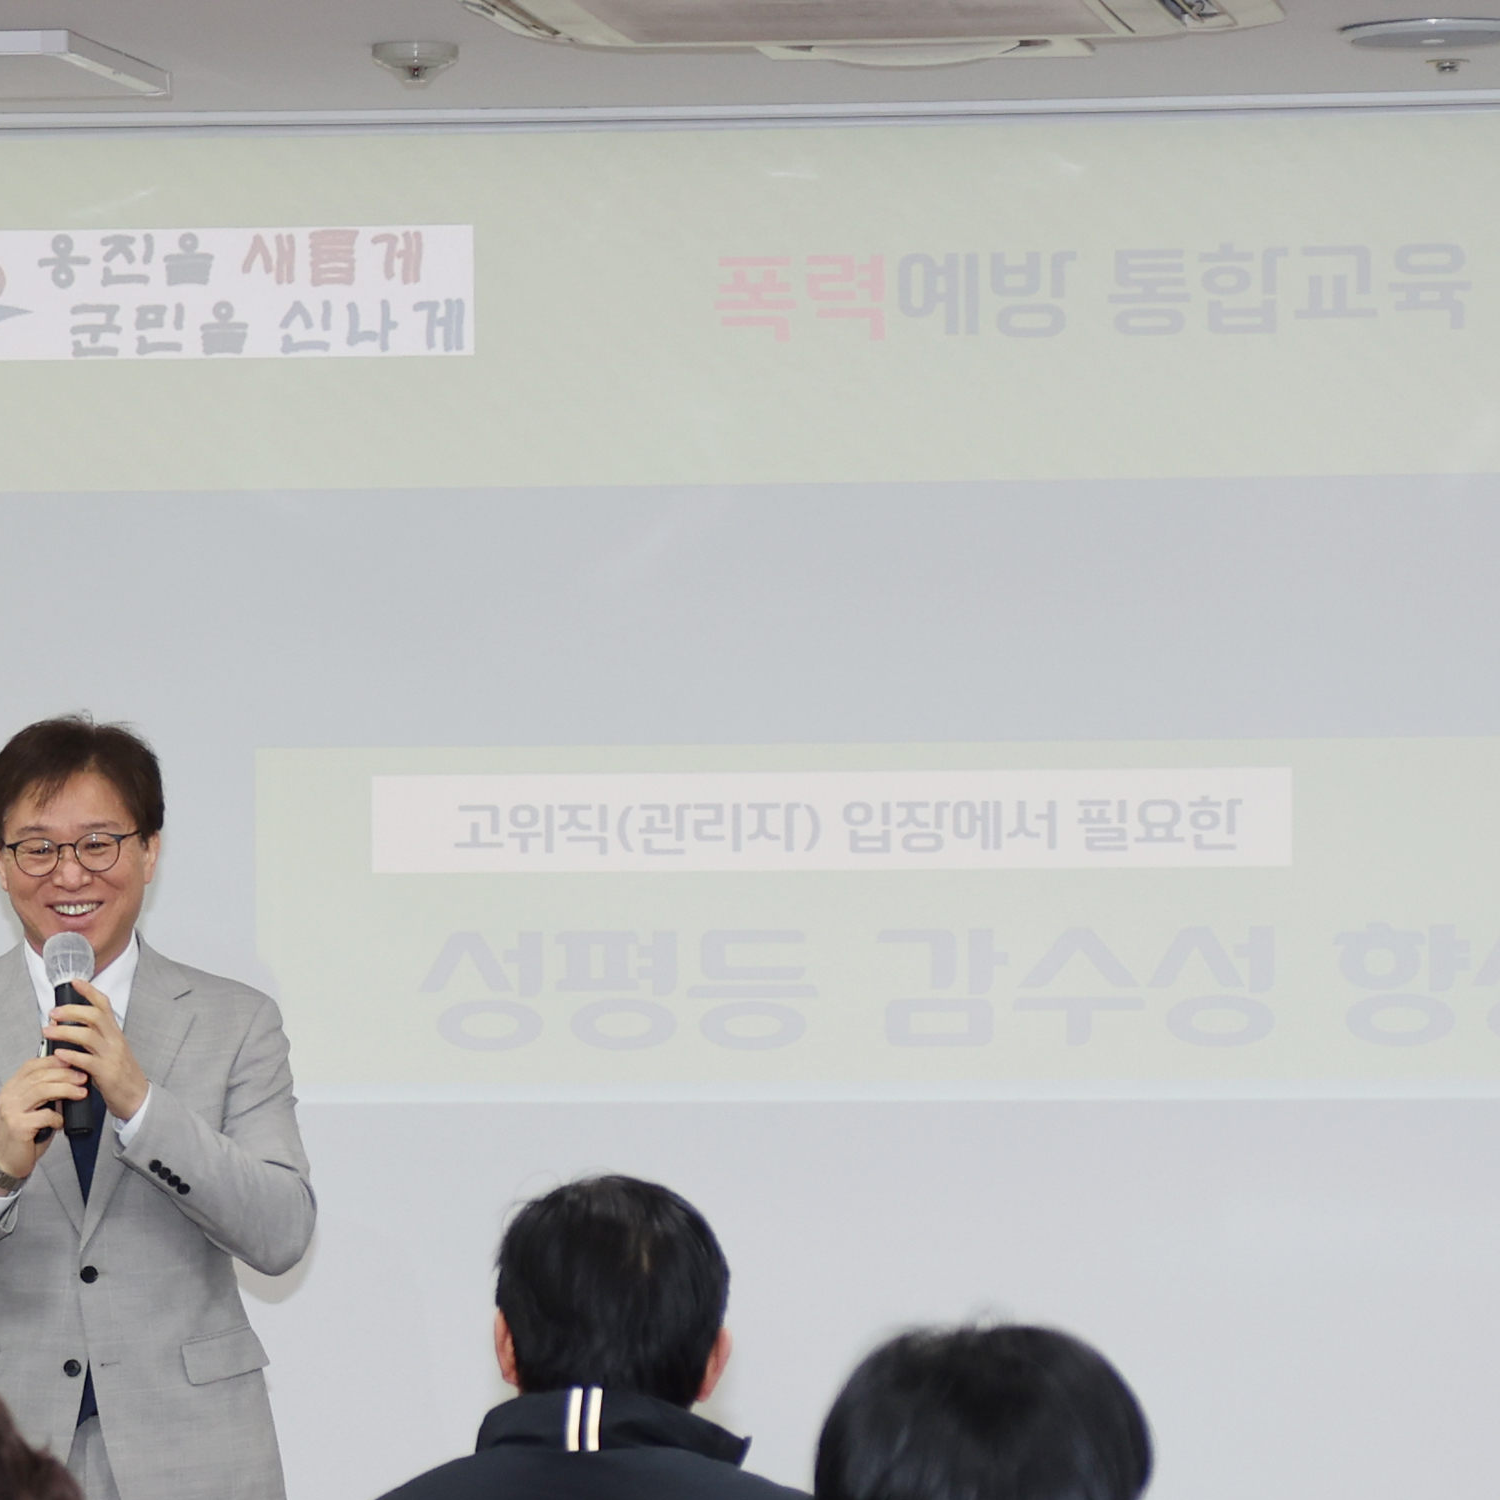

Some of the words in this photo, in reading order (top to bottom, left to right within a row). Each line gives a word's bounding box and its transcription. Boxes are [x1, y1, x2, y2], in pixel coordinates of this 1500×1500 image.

[37, 233, 215, 289] 웅진을
[241, 229, 424, 286] 새롭게
[713, 250, 1078, 342] 폭력예방
[1107, 241, 1473, 336] 통합교육
[69, 300, 249, 357] 군민을
[279, 297, 466, 353] 신나게
[453, 801, 822, 856] 고위직(관리자)
[841, 799, 1058, 854] 입장에서
[1076, 794, 1244, 853] 필요한
[417, 928, 820, 1052] 성평등
[875, 923, 1278, 1048] 감수성
